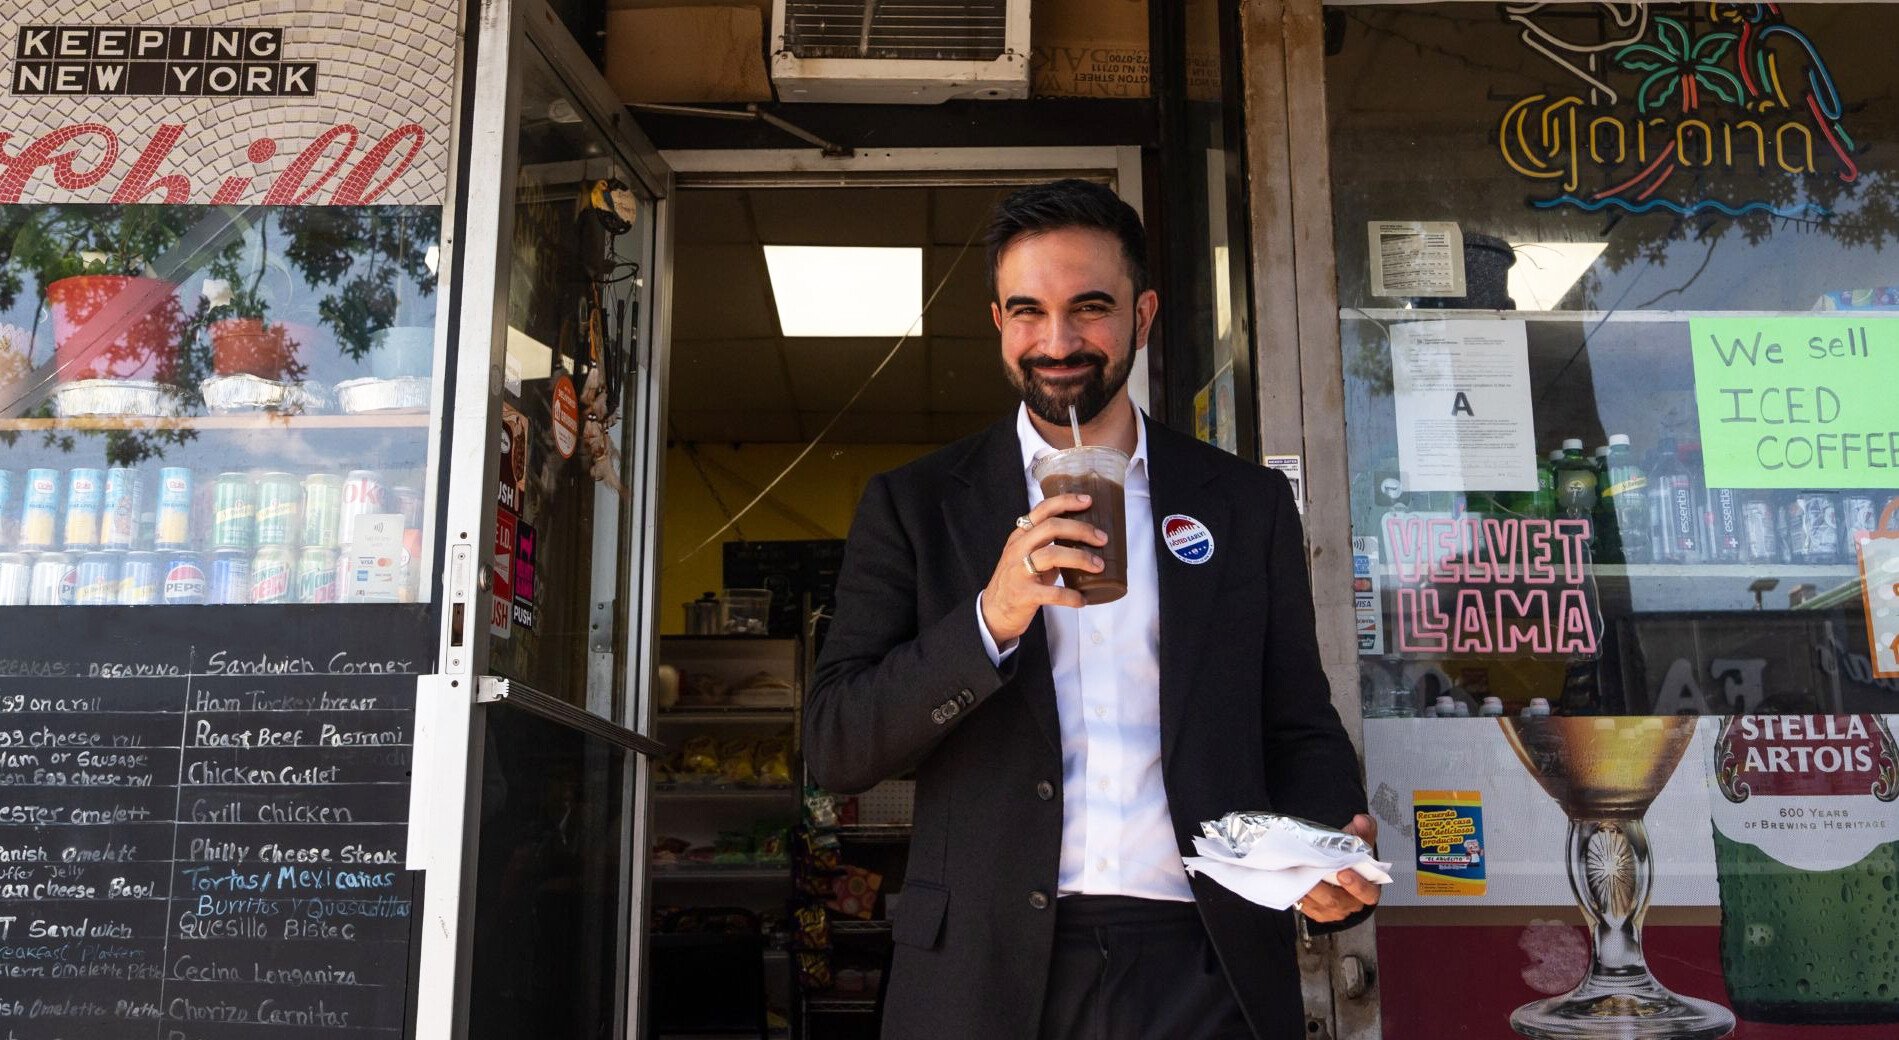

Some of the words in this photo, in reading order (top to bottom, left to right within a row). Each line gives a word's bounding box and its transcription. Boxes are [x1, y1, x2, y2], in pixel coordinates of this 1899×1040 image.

[22, 29, 278, 57] KEEPING
[16, 64, 125, 92] NEW
[174, 65, 312, 92] YORK
[1501, 95, 1816, 192] Corona
[1710, 331, 1784, 367] We
[1808, 327, 1869, 359] sell
[1451, 392, 1474, 417] A
[1719, 386, 1841, 424] ICED
[1677, 489, 1690, 533] essentia
[1720, 487, 1733, 533] essentia
[1386, 518, 1590, 584] VELVET
[513, 605, 532, 627] PUSH
[1399, 588, 1597, 653] LLAMA
[206, 650, 314, 675] Sandwich
[328, 652, 412, 674] Corner
[72, 697, 101, 711] roll
[196, 690, 240, 712] Ham
[245, 690, 316, 715] Turkey
[30, 725, 101, 748] cheese
[194, 719, 252, 749] Roast
[257, 728, 303, 747] Beef
[1741, 714, 1870, 741] STELLA
[51, 752, 71, 764] or
[77, 751, 148, 768] Sausage
[1744, 746, 1873, 773] ARTOIS
[34, 768, 66, 786] Egg
[71, 769, 121, 786] cheese
[127, 773, 152, 788] roll
[188, 761, 275, 785] Chicken
[280, 765, 340, 785] Cutlet
[191, 799, 242, 823] Grill
[1779, 808, 1804, 818] 600
[190, 839, 250, 863] Philly
[341, 845, 397, 864] Steak
[44, 864, 84, 881] Jelly
[0, 883, 29, 898] an
[108, 877, 155, 899] Bagel
[196, 894, 280, 917] Burritos
[29, 918, 133, 939] Sandwich
[179, 911, 268, 940] Quesillo
[174, 955, 240, 981] Cecina
[254, 963, 358, 987] Longaniza
[169, 998, 248, 1021] Chorizo
[257, 999, 349, 1027] Carnitas
